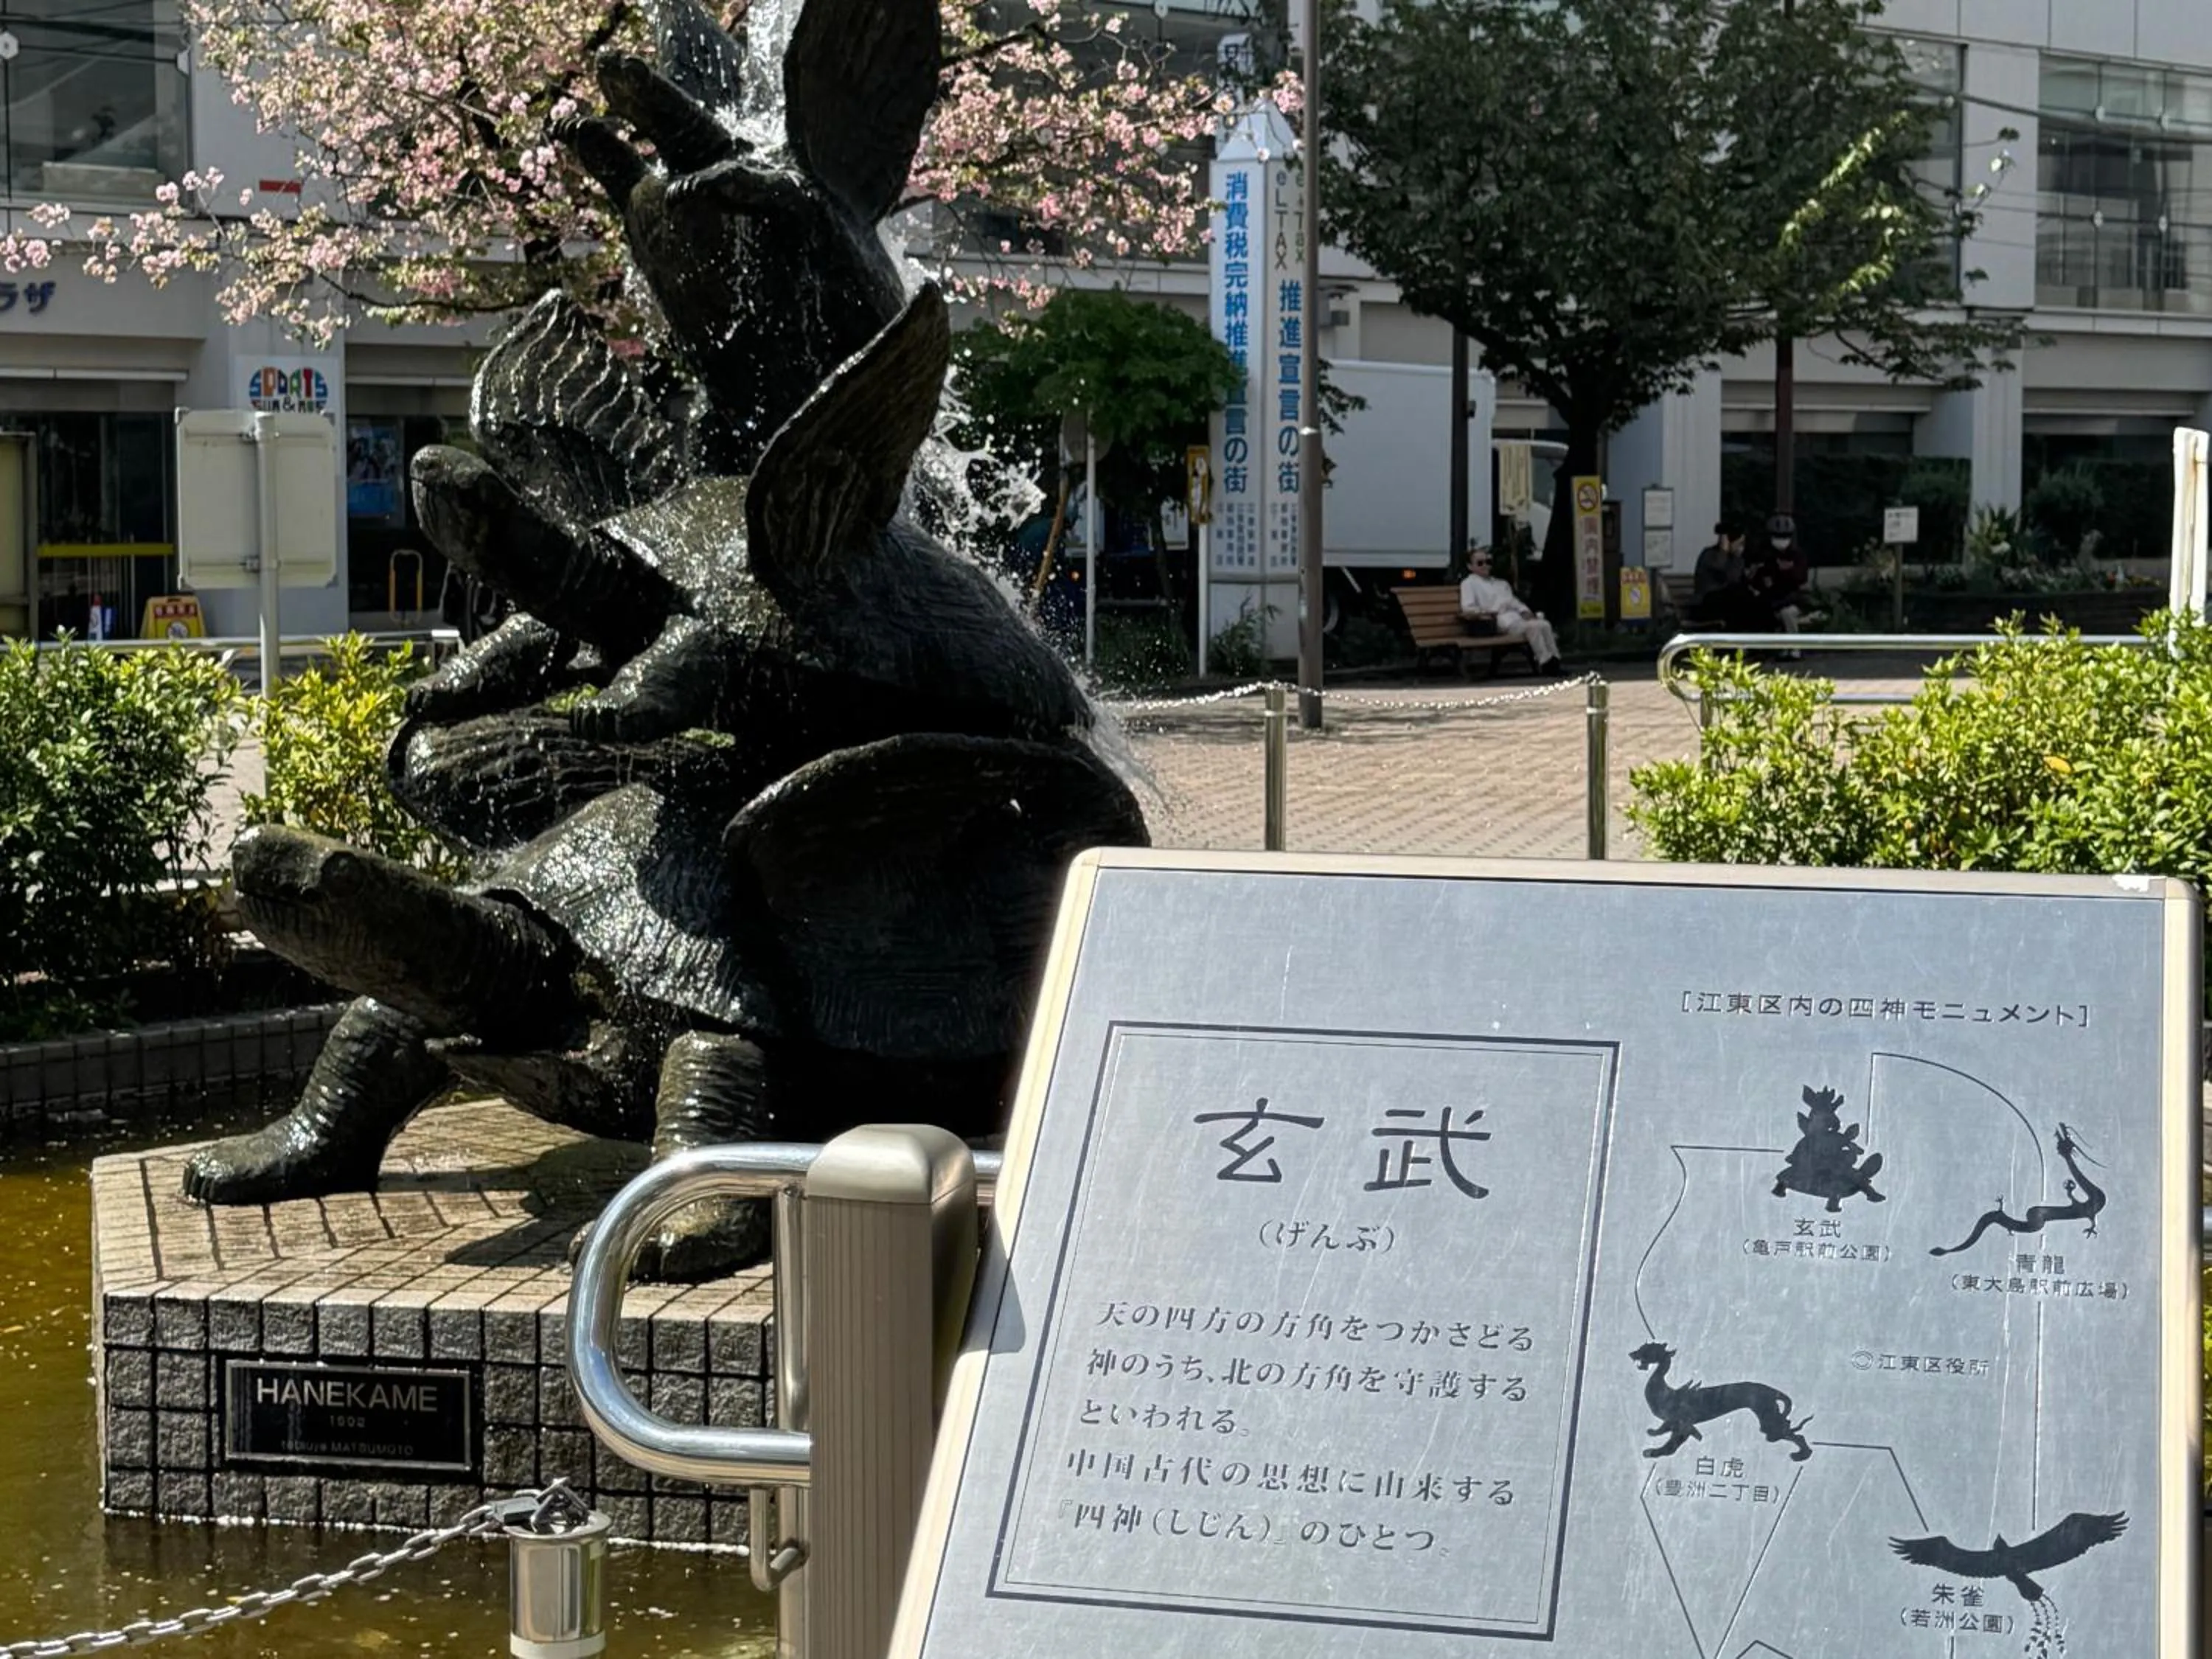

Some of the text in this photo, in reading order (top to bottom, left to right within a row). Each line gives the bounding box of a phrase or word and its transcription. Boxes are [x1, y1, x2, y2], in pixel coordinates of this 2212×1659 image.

[1274, 170, 1288, 271] eLTAX
[249, 366, 328, 398] SPORTS
[1278, 278, 1303, 495] 推進宣言の街
[1194, 1097, 1492, 1199] 玄武
[1258, 1219, 1397, 1254] （げんぶ）
[1793, 1218, 1842, 1239] 玄武
[1742, 1238, 1891, 1263] （亀戸駅前公園）
[2017, 1253, 2066, 1275] 青龍
[1952, 1273, 2129, 1300] （東大島駅前広場）
[1097, 1300, 1534, 1352] 天の四方の方角をつかさどる
[1086, 1347, 1528, 1402] 神のうち、北の方角を守護する
[257, 1377, 439, 1413] HANEKAME
[1078, 1398, 1251, 1437] といわれる。
[1067, 1448, 1515, 1506] 中国古代の思想に由来する
[1696, 1455, 1745, 1478] 白虎
[1655, 1478, 1780, 1503] （豊洲二丁目）
[1931, 1582, 1985, 1607] 朱雀
